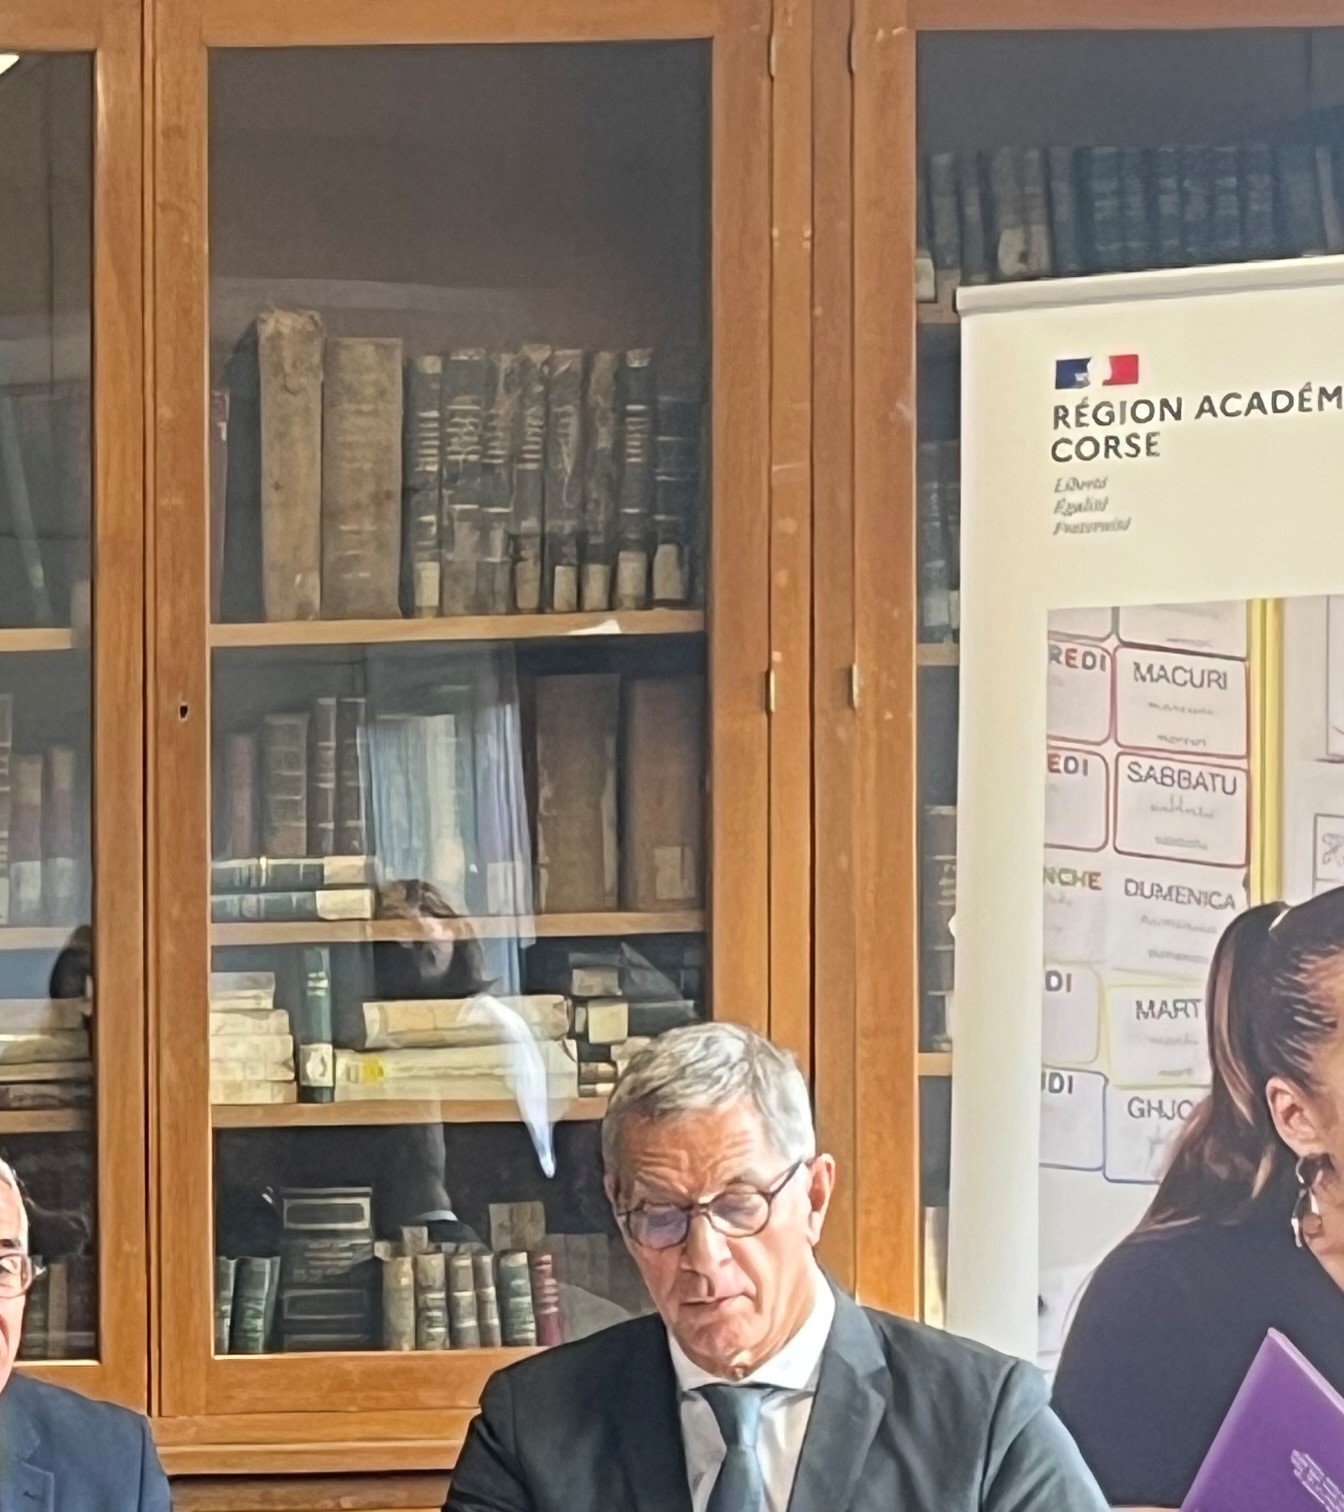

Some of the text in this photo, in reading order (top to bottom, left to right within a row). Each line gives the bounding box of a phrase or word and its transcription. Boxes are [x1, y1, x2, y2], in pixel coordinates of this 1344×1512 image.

[1053, 381, 1344, 430] RÉGION ACADÉM
[1051, 431, 1160, 462] CORSE
[1132, 661, 1228, 690] MACURI
[1127, 761, 1237, 795] SABBATU
[1124, 878, 1235, 910] DUMENICA
[1041, 1071, 1073, 1094] DI
